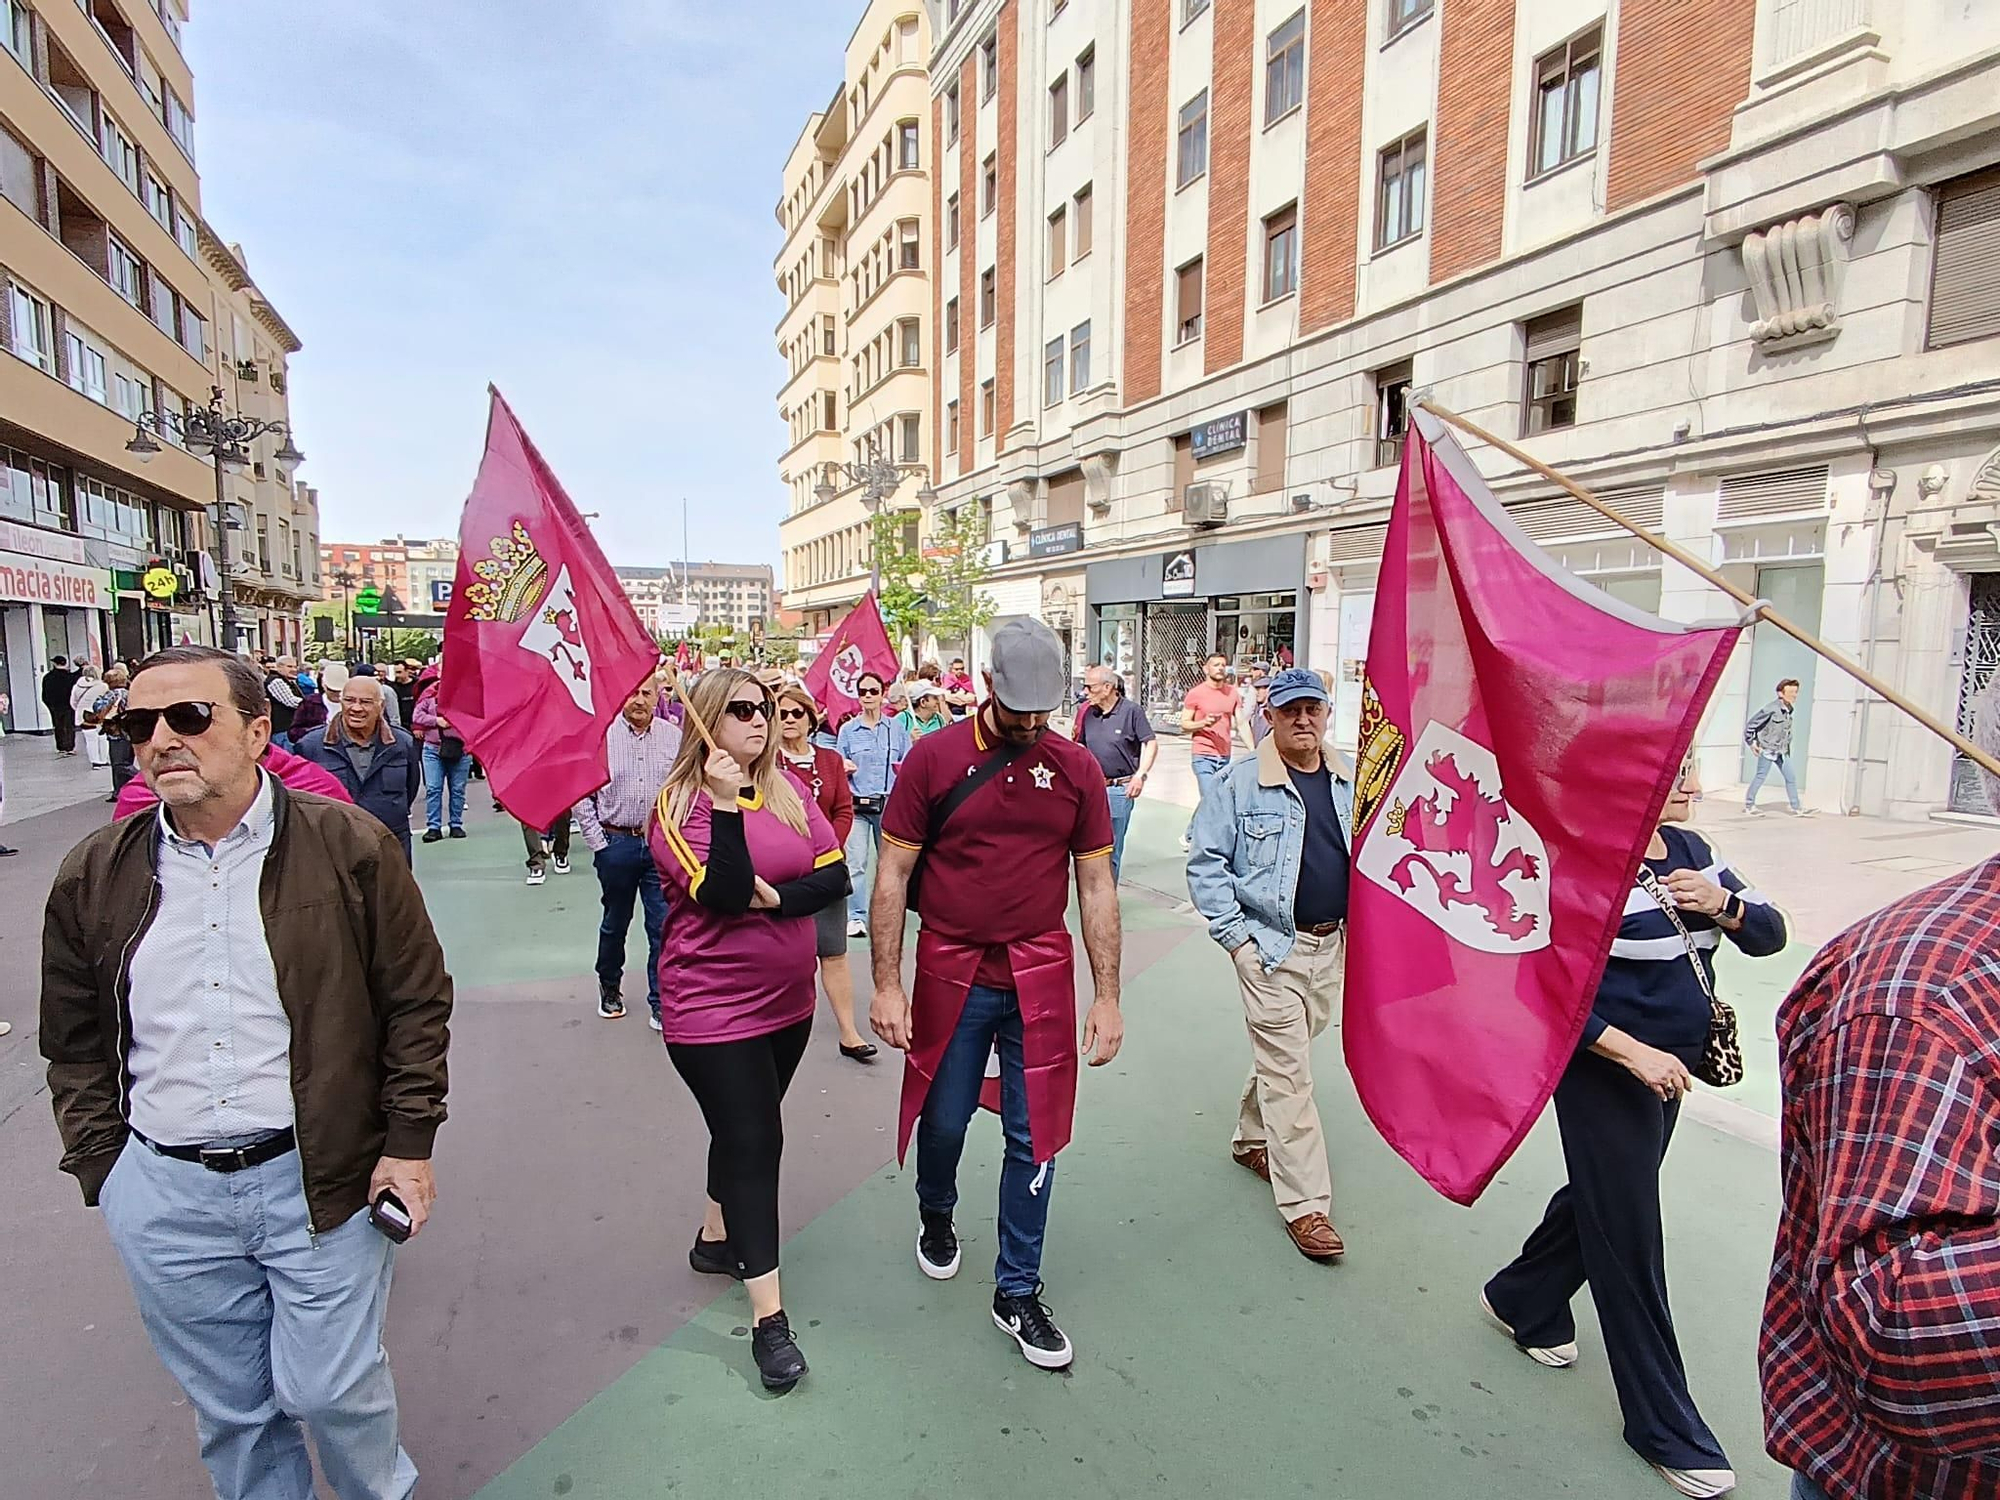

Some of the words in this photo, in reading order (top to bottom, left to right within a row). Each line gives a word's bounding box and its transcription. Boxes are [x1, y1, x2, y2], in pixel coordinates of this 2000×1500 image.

[1207, 427, 1241, 447] DENTAL
[0, 562, 51, 600] macia
[54, 566, 96, 605] sirera
[146, 575, 175, 592] 24h
[438, 582, 453, 601] P
